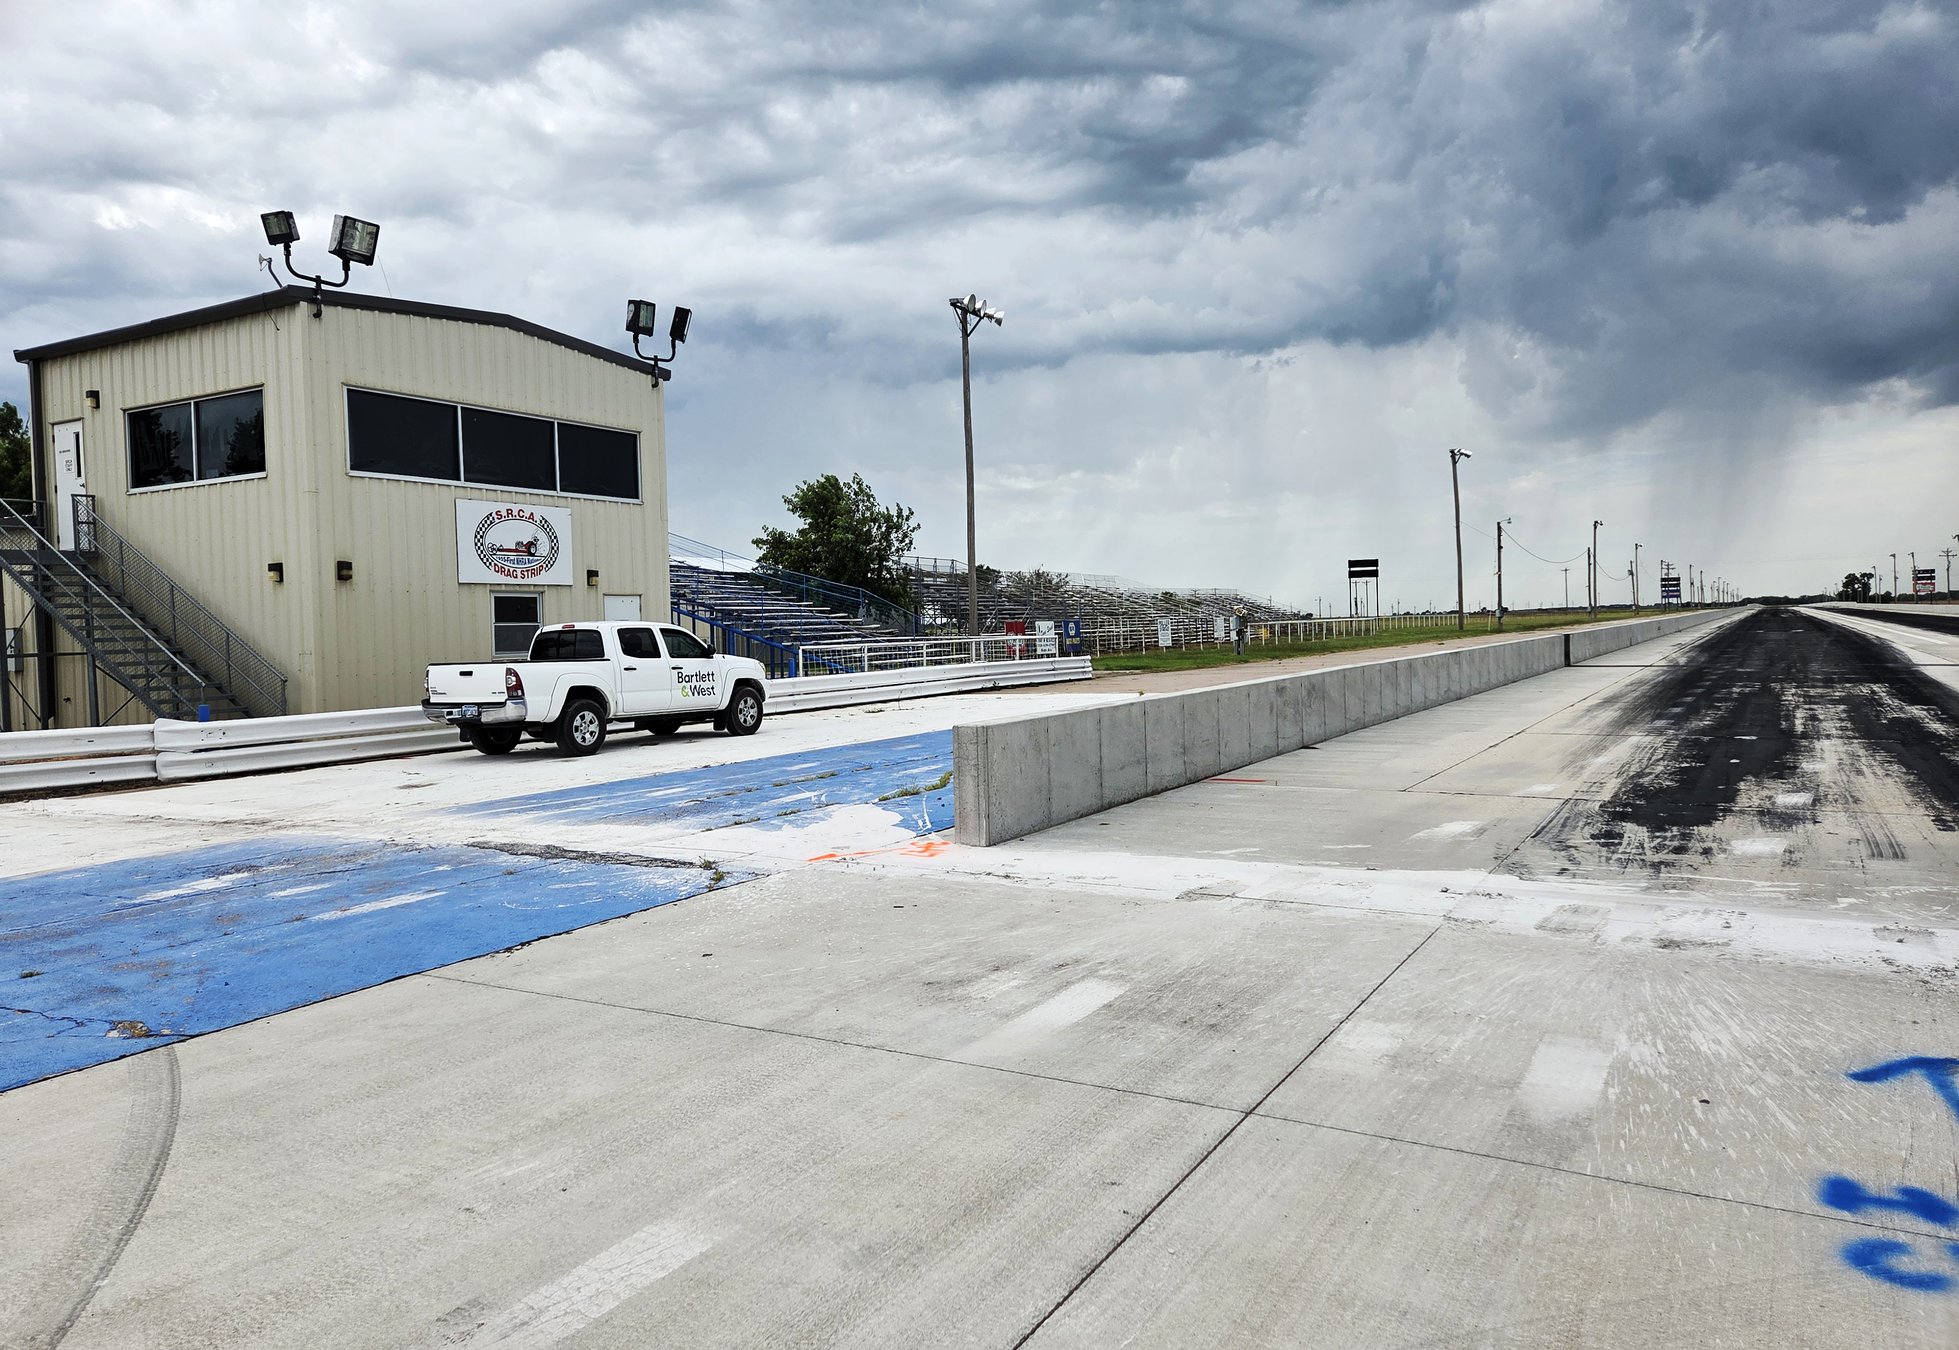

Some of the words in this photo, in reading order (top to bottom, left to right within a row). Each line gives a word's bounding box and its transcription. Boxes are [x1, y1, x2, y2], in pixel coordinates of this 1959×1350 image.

[495, 508, 537, 523] S.R.C.A.
[493, 563, 518, 579] DRAG
[520, 565, 544, 580] STRIP
[677, 670, 715, 683] Bartlett
